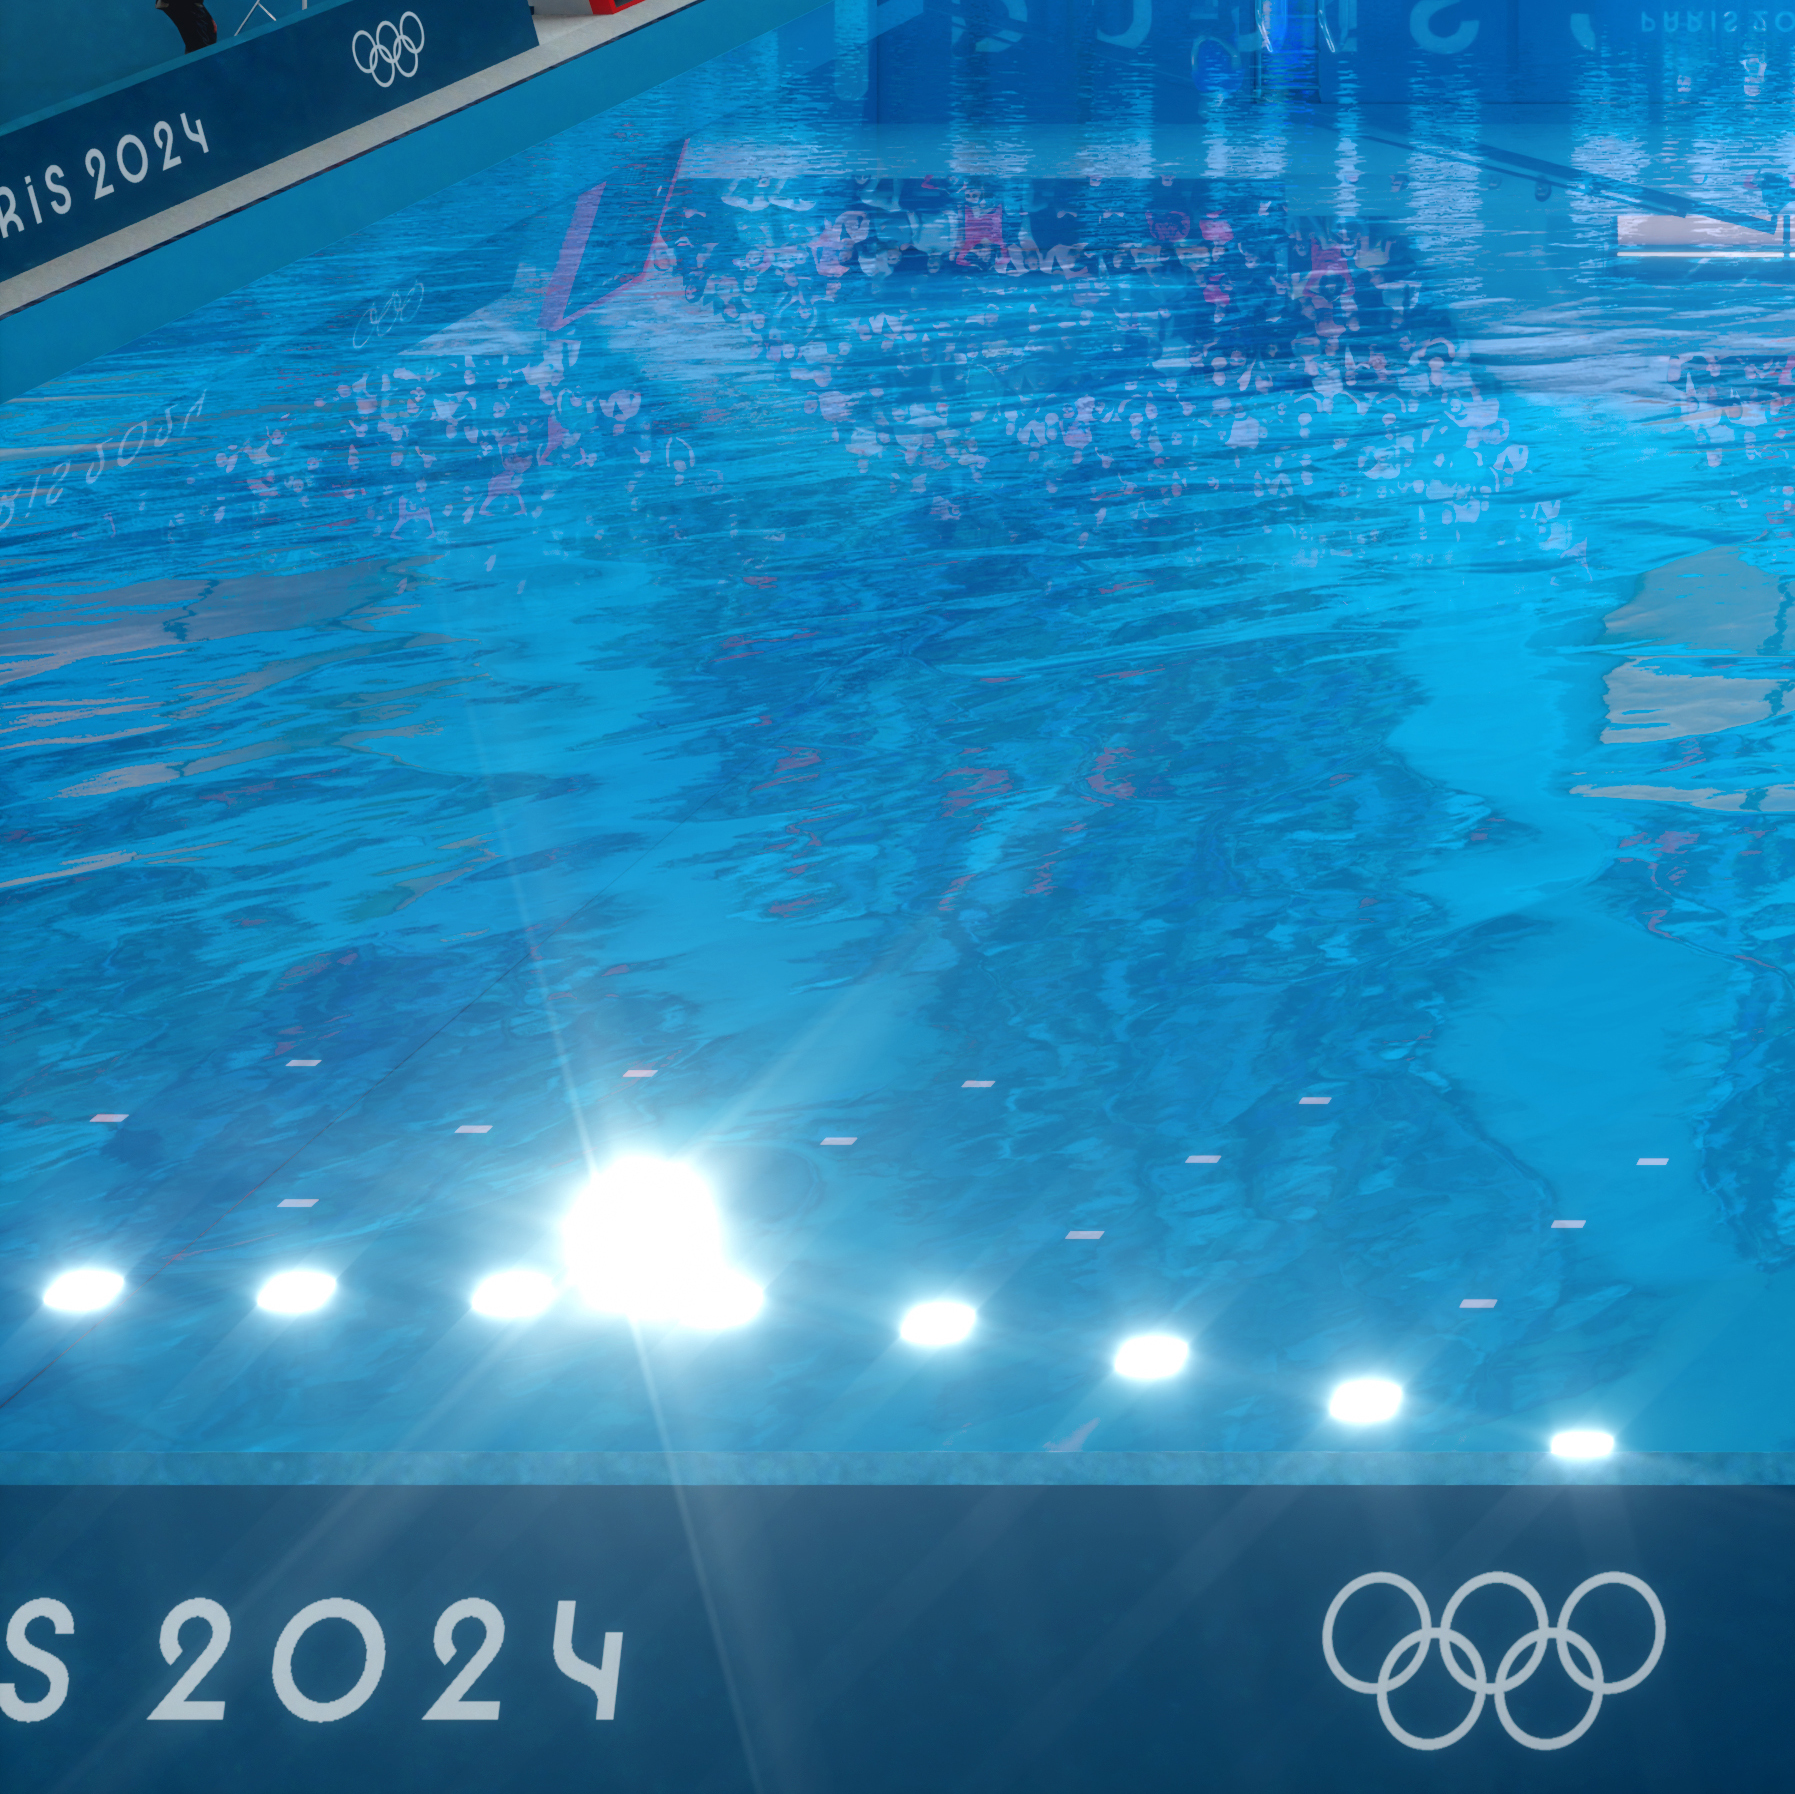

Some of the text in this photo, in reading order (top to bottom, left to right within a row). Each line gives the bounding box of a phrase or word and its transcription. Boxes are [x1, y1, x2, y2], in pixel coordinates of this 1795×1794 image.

[84, 112, 210, 200] 2024
[0, 1597, 624, 1724] S 2024
